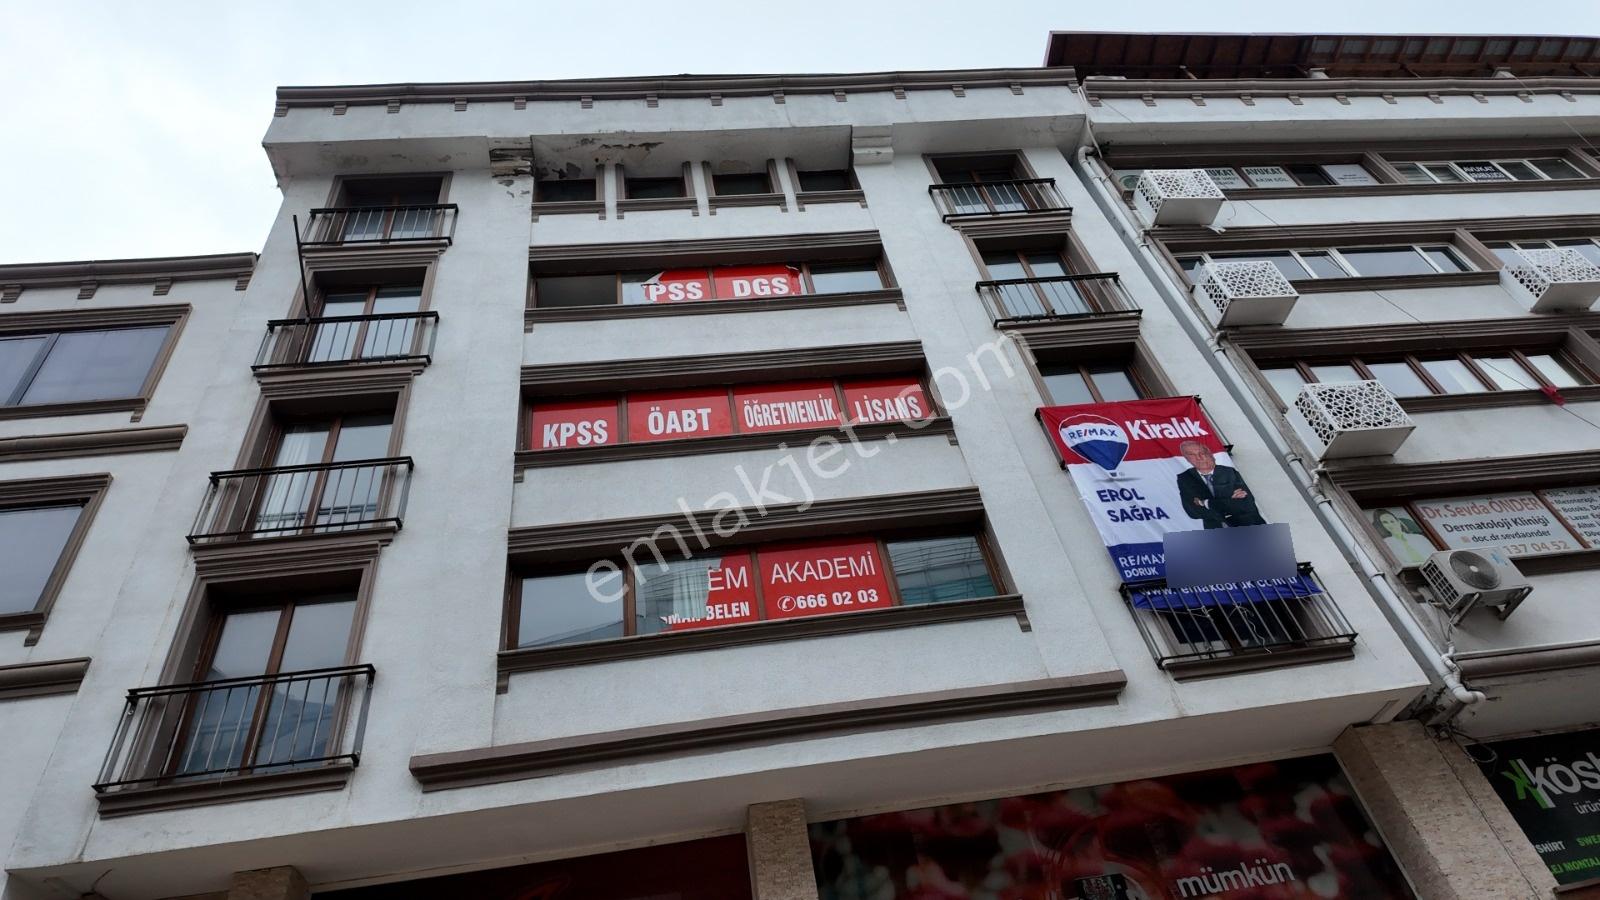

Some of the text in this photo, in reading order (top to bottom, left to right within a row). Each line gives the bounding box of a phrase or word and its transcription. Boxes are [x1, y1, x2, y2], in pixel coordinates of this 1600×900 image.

[1245, 167, 1283, 176] AVUKAT
[732, 276, 789, 297] DGS
[543, 394, 923, 449] KPSS ÖABT ÖĞRETMENLİK LİSANS
[1125, 416, 1209, 441] Kiralık
[1068, 427, 1119, 441] RE/MAX
[1096, 487, 1145, 503] EROL
[1107, 504, 1171, 524] SAĞRA
[1488, 496, 1544, 514] ÖNDER
[1443, 514, 1552, 533] Dermatoloji Kliniği
[1530, 542, 1551, 552] 04
[1551, 540, 1571, 550] 52
[770, 550, 876, 585] AKADEMİ
[1118, 553, 1165, 568] RE/MAX
[1124, 567, 1159, 578] DORUK
[795, 588, 879, 610] 666 02 03
[706, 601, 750, 621] BELEN
[1576, 834, 1600, 847] SWE
[1177, 858, 1296, 898] mümkün
